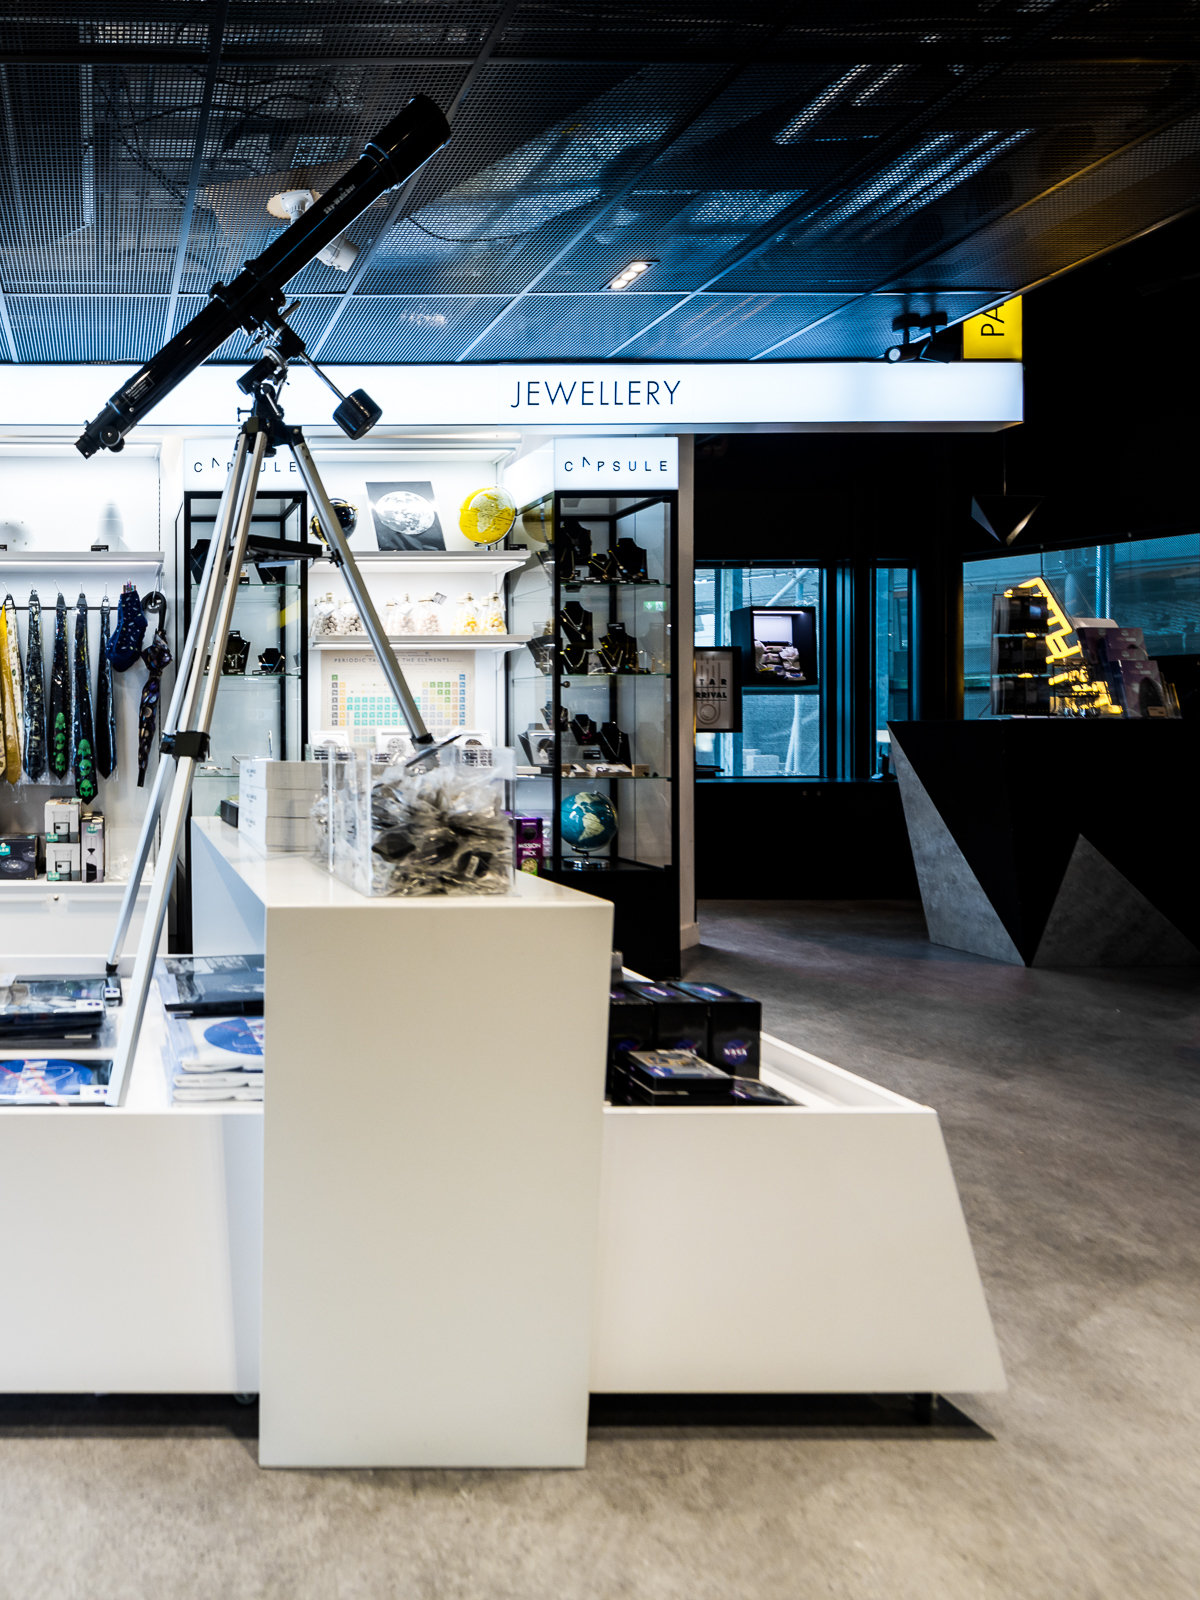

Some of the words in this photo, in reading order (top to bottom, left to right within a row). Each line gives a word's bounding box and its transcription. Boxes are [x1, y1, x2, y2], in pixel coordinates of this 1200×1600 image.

[510, 380, 681, 408] JEWELLERY
[194, 457, 297, 472] CAPULE
[564, 456, 668, 472] CAPSULE
[723, 1047, 748, 1056] NASA
